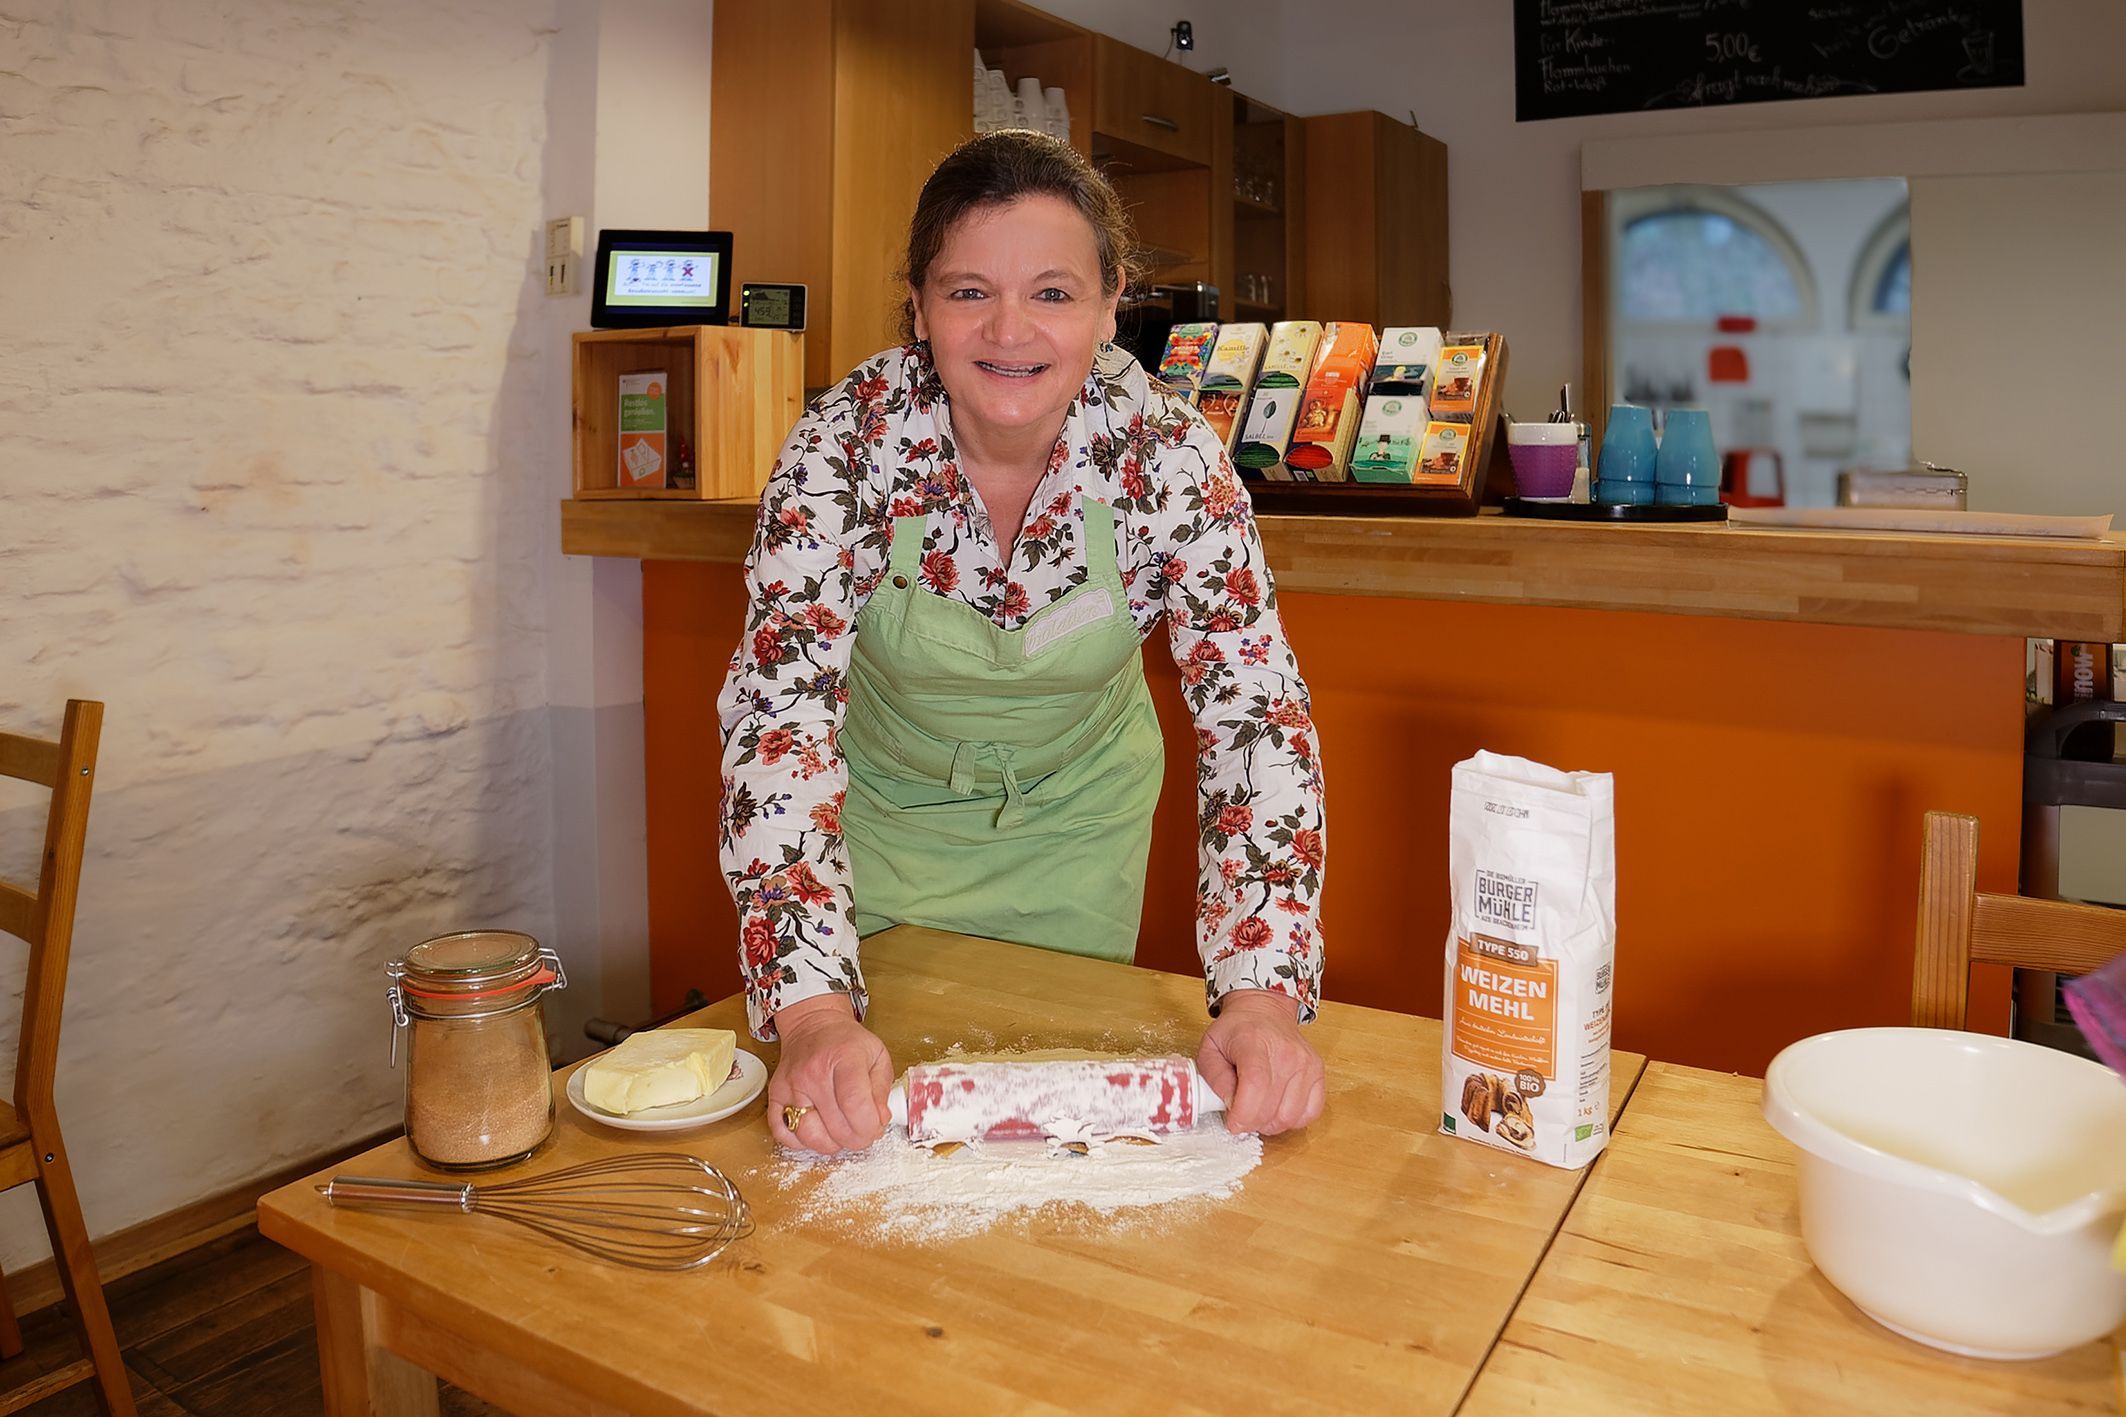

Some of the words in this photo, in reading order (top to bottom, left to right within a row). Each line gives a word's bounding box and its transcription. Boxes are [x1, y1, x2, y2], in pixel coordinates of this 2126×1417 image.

[1478, 877, 1533, 903] BURGER
[1478, 895, 1532, 923] MÜHLE
[1477, 939, 1506, 956] TYPE
[1507, 946, 1529, 961] 550
[1460, 963, 1547, 999] WEIZEN
[1468, 989, 1535, 1021] MEHL
[1519, 1081, 1540, 1093] BIO
